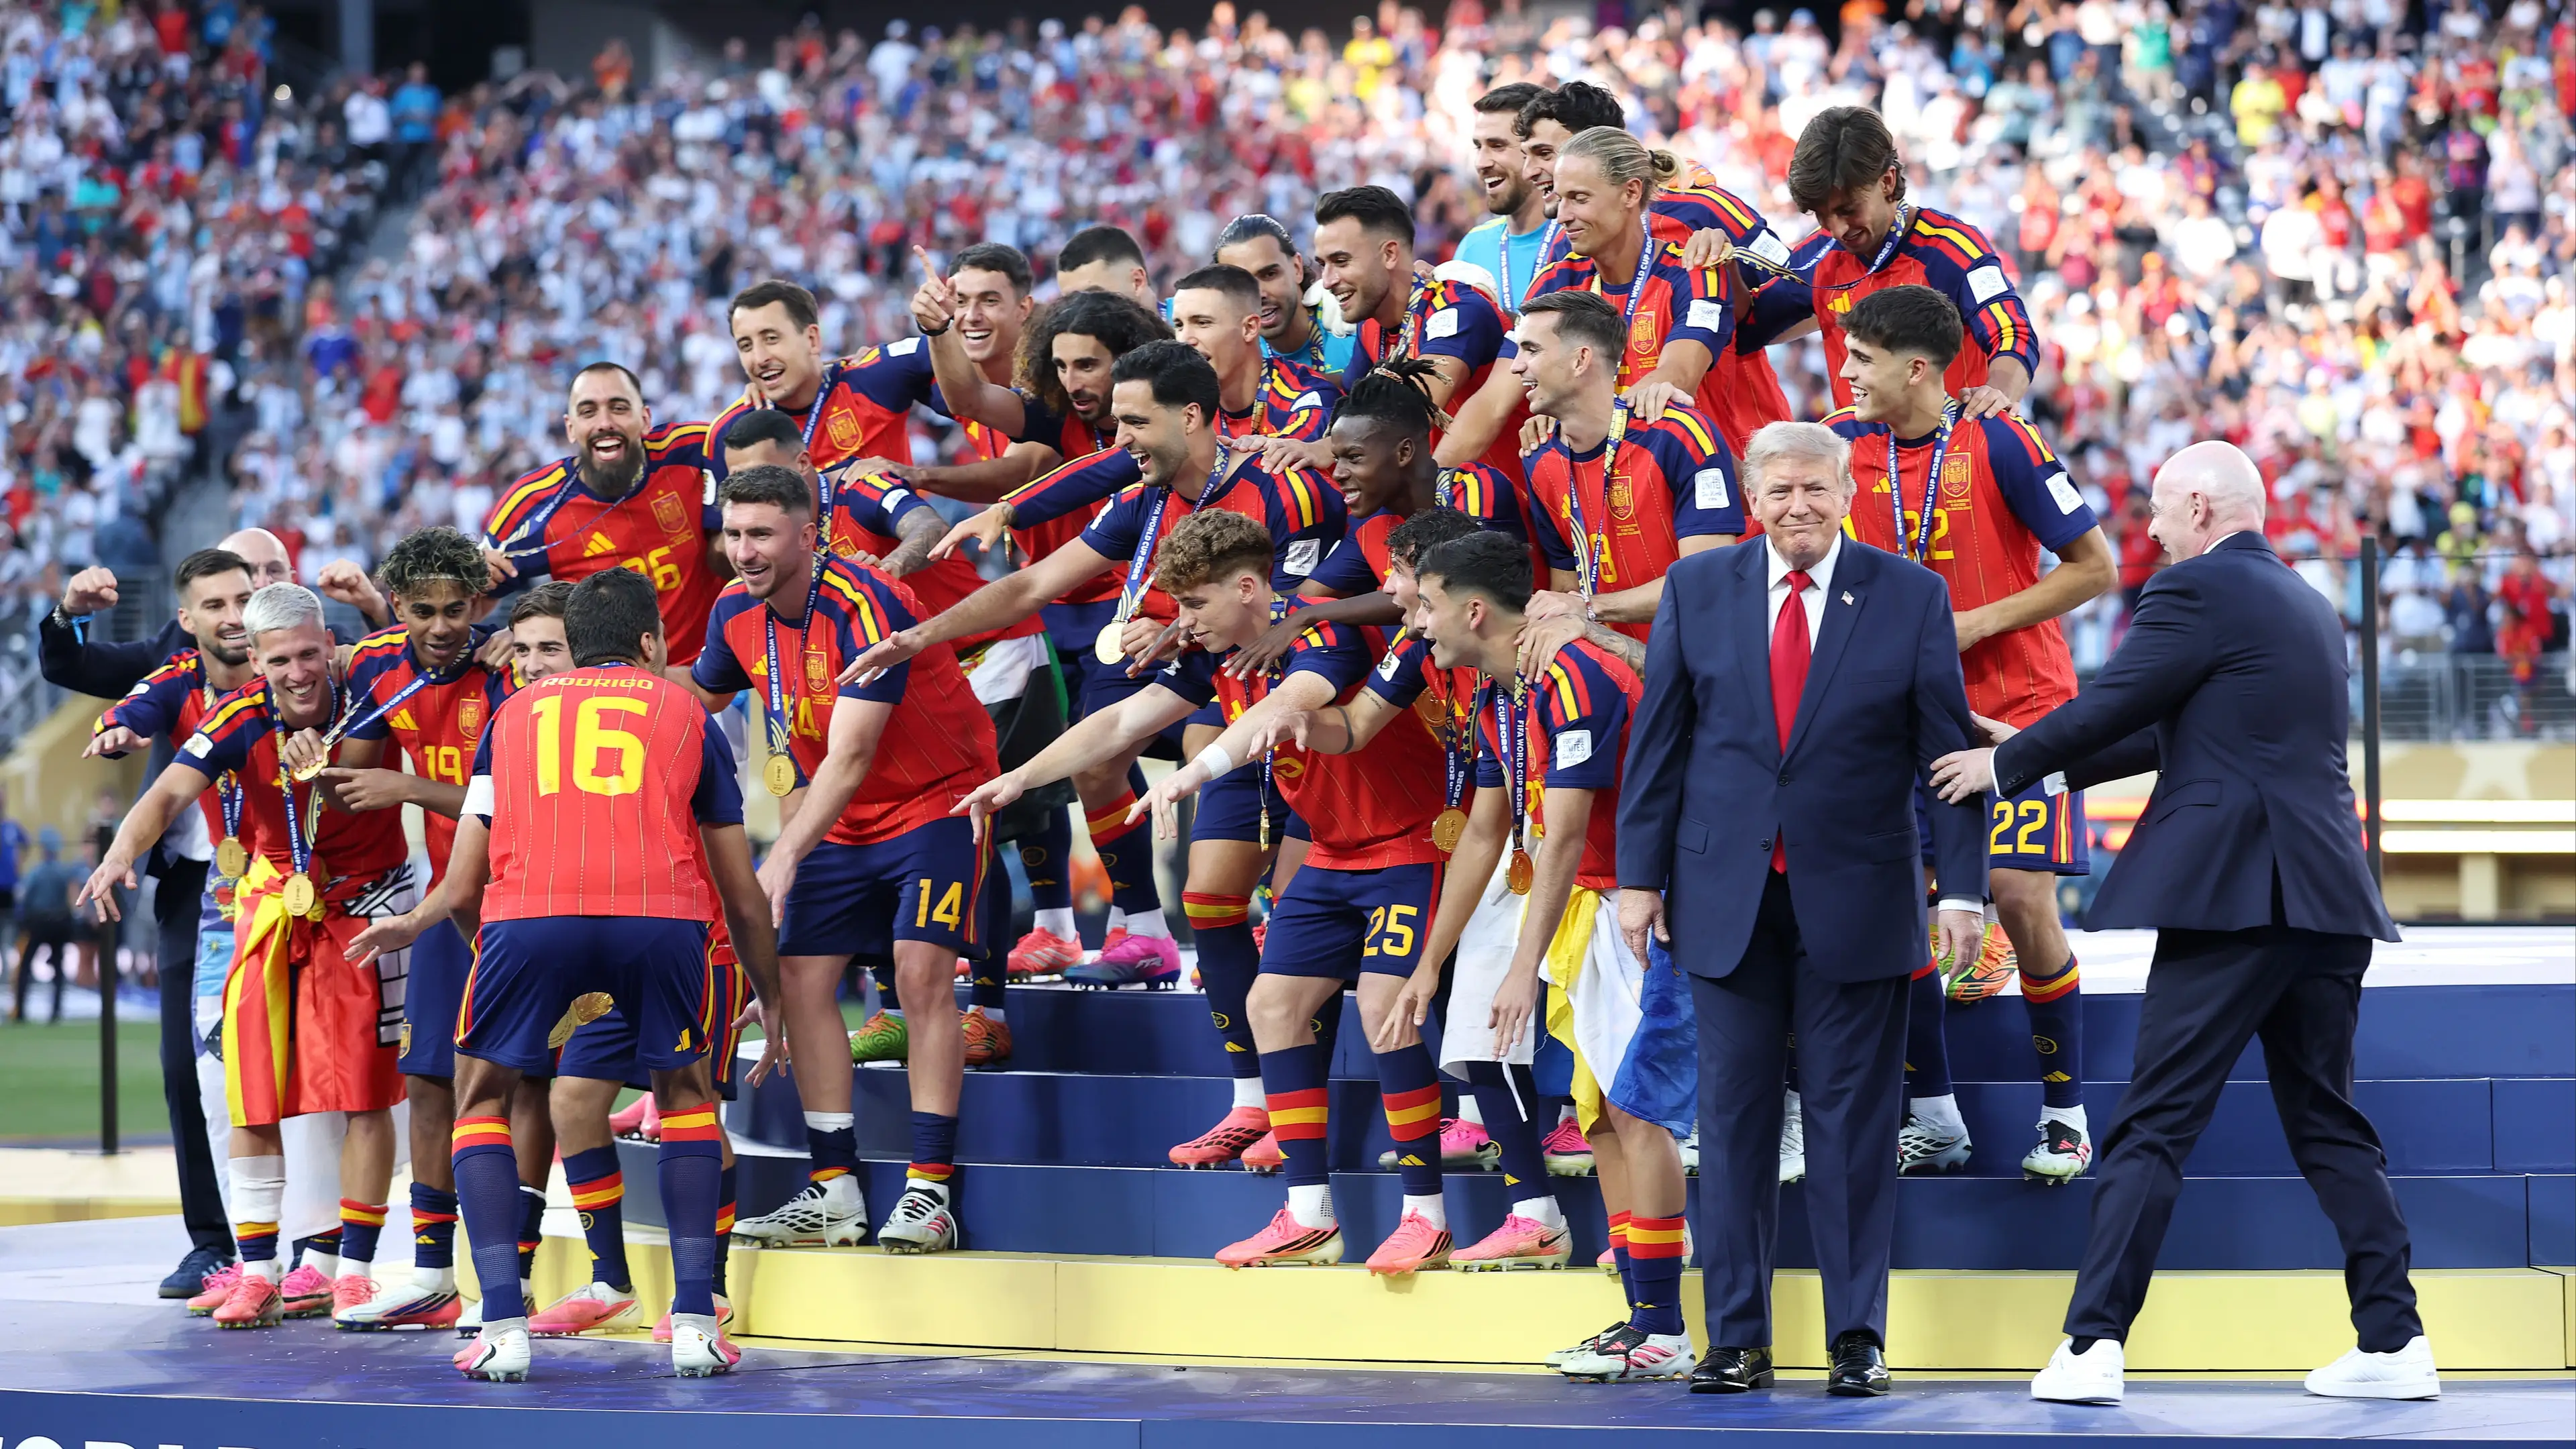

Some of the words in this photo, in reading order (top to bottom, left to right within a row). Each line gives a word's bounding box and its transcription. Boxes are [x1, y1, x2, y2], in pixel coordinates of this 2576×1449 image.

[1539, 242, 1548, 258] CUP
[1817, 245, 1830, 259] FIFA
[1874, 241, 1893, 265] 2026
[1626, 299, 1635, 315] FIFA
[1631, 270, 1645, 298] WORLD
[1640, 254, 1650, 269] CUP
[1931, 449, 1942, 478] 2026
[1202, 483, 1214, 500] FIFA
[1889, 460, 1897, 489] WORLD
[1894, 506, 1903, 535] 2026
[1928, 478, 1936, 494] CUP
[1153, 500, 1164, 517] FIFA
[1923, 496, 1933, 525] WORLD
[1145, 516, 1159, 541] WORLD
[1919, 527, 1927, 543] FIFA
[1140, 541, 1150, 555] CUP
[1131, 557, 1145, 580] 2026
[808, 590, 816, 607] FIFA
[769, 639, 777, 665] WORLD
[541, 678, 654, 690] RODRIGO
[770, 667, 778, 683] CUP
[368, 704, 390, 722] WORLD
[389, 694, 403, 706] CUP
[402, 678, 425, 697] 2026
[771, 684, 780, 711] 2026
[1497, 705, 1506, 722] CUP
[1499, 724, 1508, 753] 2026
[1516, 720, 1524, 737] FIFA
[531, 695, 649, 798] 16
[1516, 739, 1524, 769] WORLD
[424, 745, 464, 786] 19
[1453, 771, 1464, 798] 2026
[223, 803, 231, 820] FIFA
[287, 803, 295, 820] FIFA
[290, 821, 300, 852] WORLD
[1989, 800, 2047, 855] 22
[293, 851, 302, 865] CUP
[915, 878, 963, 932] 14
[1362, 904, 1418, 957] 25
